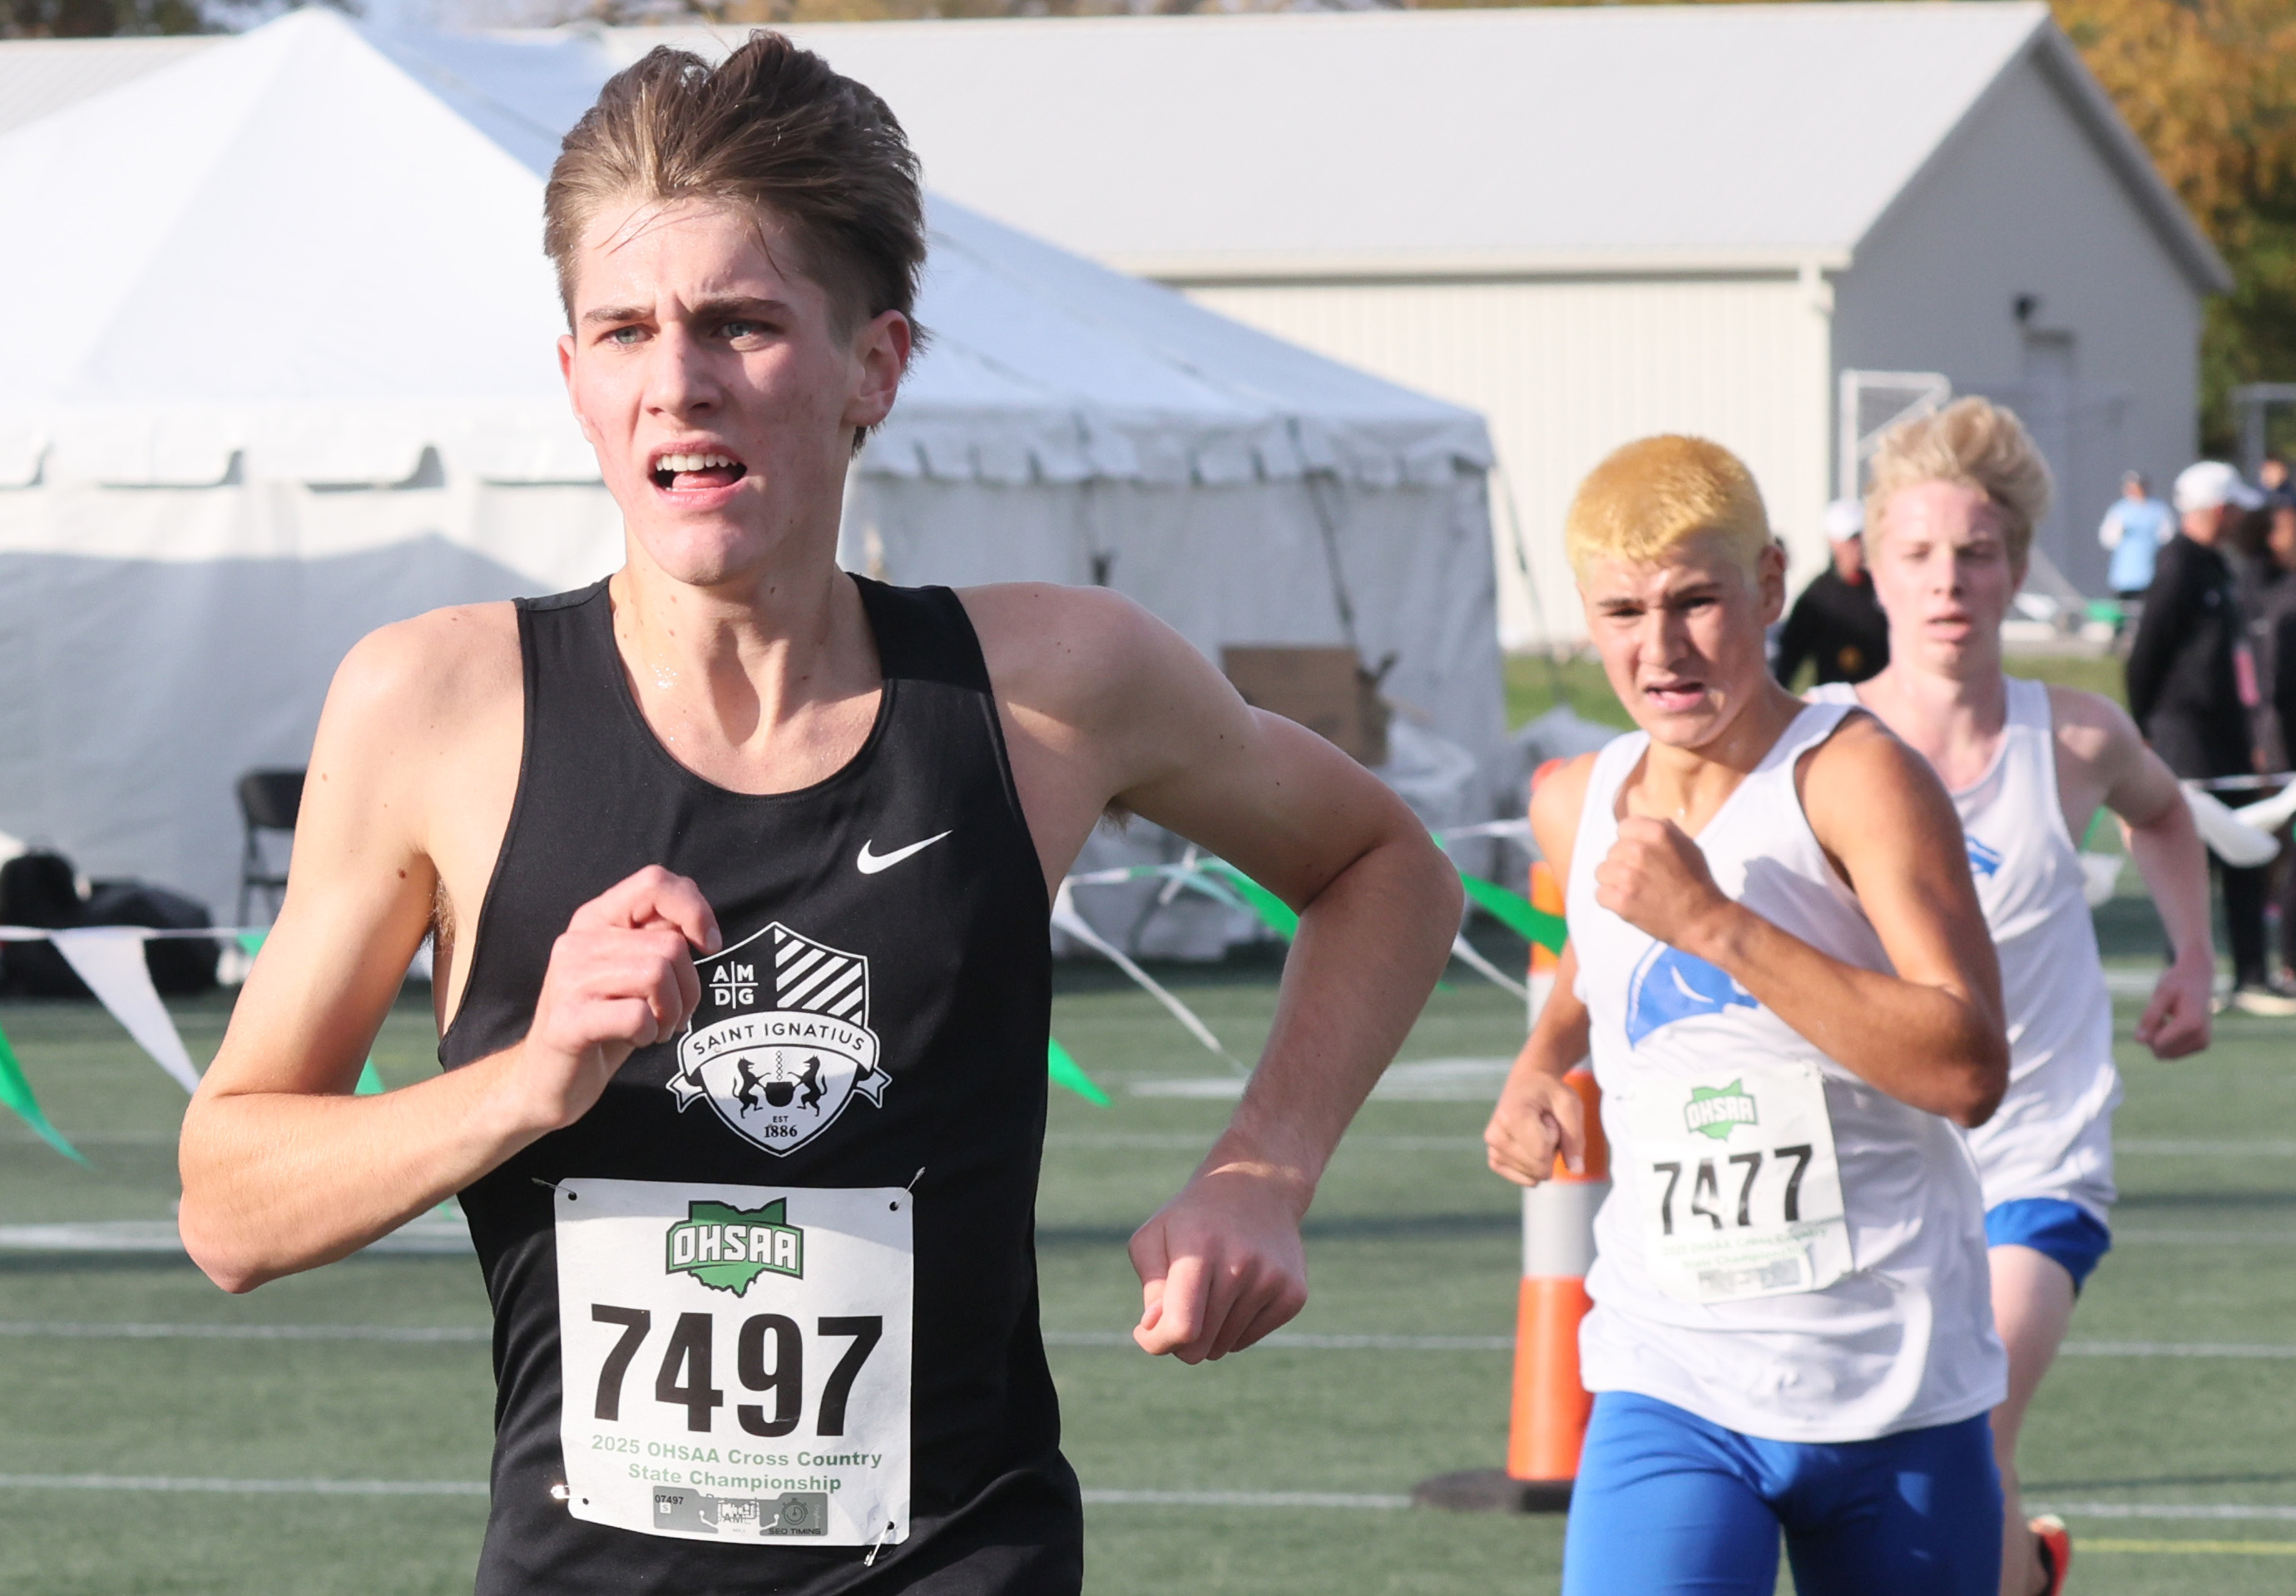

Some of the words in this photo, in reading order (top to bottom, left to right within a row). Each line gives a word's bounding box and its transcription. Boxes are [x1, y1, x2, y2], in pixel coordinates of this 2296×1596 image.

[694, 1025, 755, 1055] SAINT
[765, 1022, 865, 1050] IGNATIUS
[1685, 1096, 1754, 1129] OHSAA
[764, 1125, 798, 1138] 1886
[1653, 1144, 1813, 1235] 7477
[672, 1223, 798, 1270] OHSAA
[591, 1303, 883, 1437] 7497
[591, 1435, 641, 1455] 2025
[647, 1441, 720, 1463] OHSAA
[728, 1449, 789, 1466] Cross
[797, 1451, 883, 1469] Country
[628, 1463, 681, 1483] State
[690, 1470, 842, 1494] Championship
[655, 1494, 684, 1505] 07497
